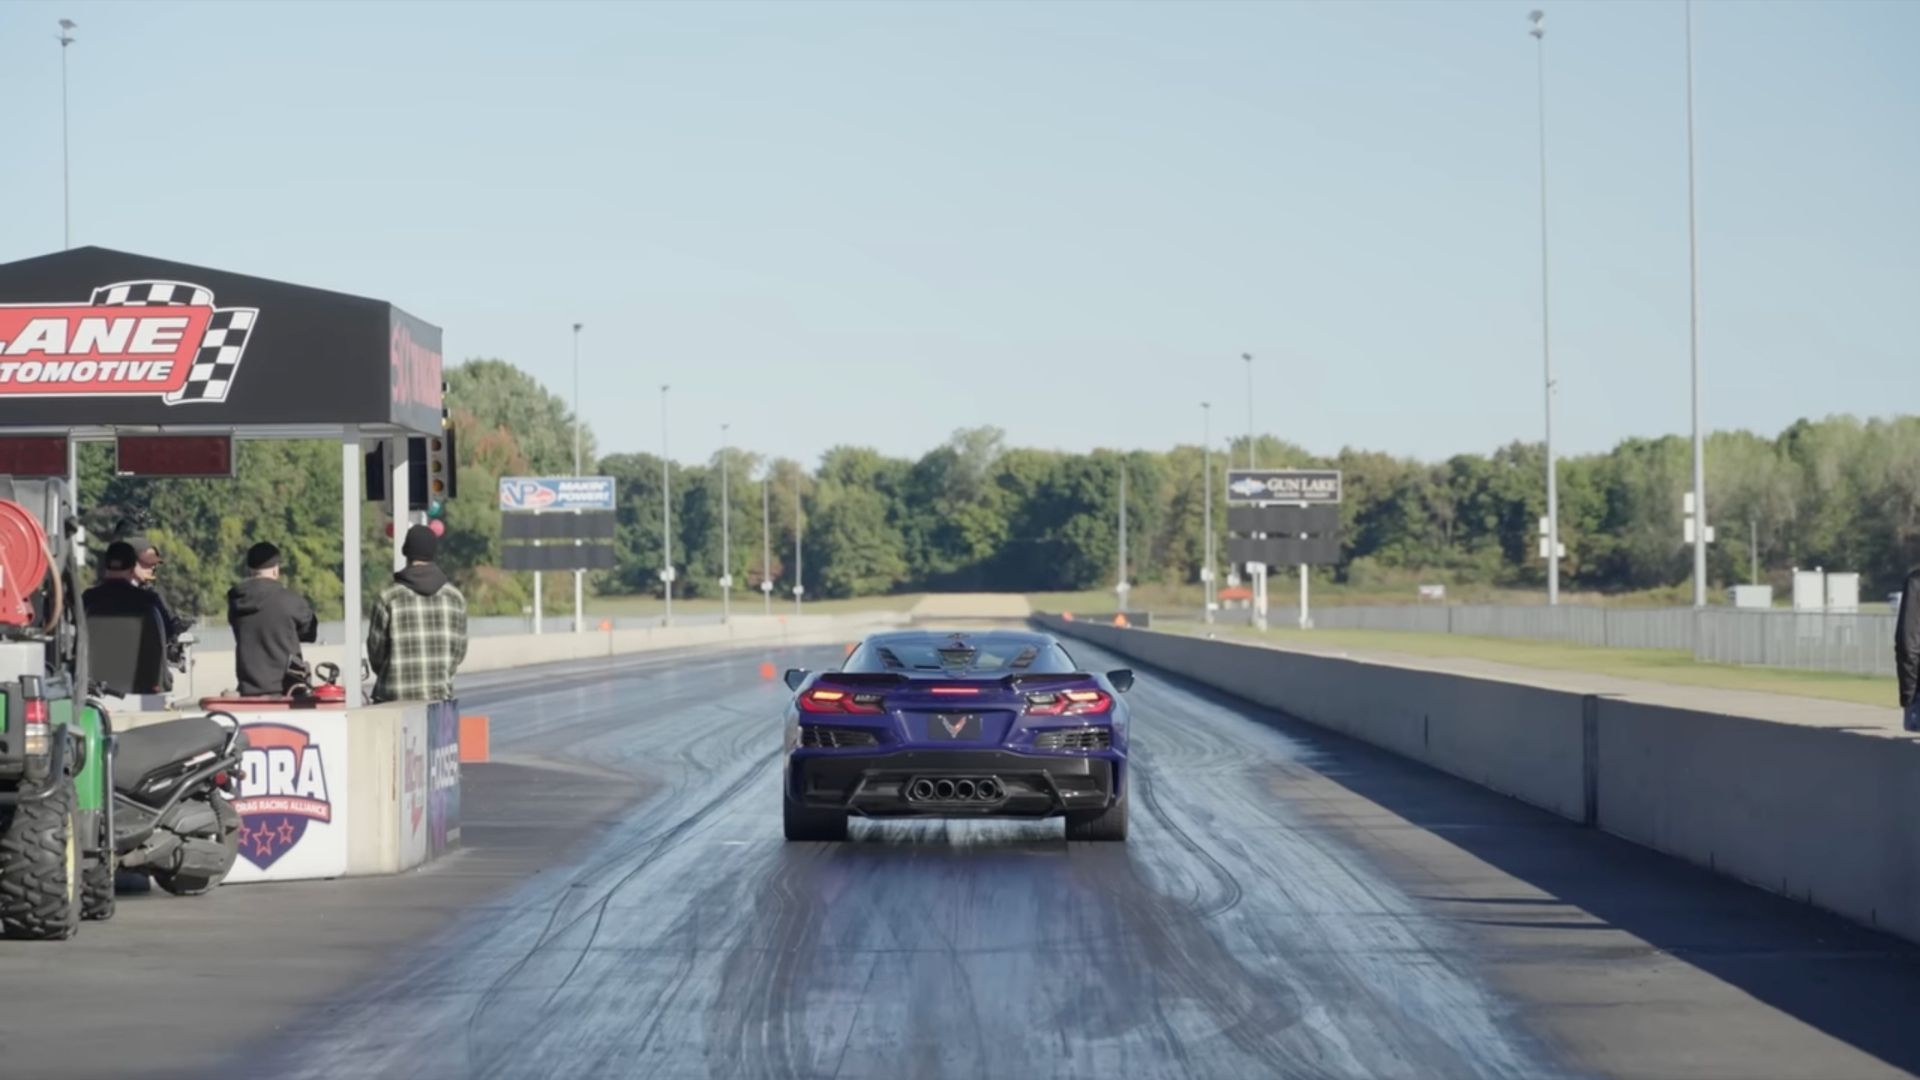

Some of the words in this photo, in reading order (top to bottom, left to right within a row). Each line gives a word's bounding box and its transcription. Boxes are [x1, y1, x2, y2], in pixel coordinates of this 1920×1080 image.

[0, 317, 189, 354] ANE
[1266, 477, 1300, 492] GUN
[1302, 478, 1337, 492] LAKE
[235, 747, 329, 800] DRA
[258, 800, 289, 811] RACING
[290, 801, 327, 816] ALLIANCE
